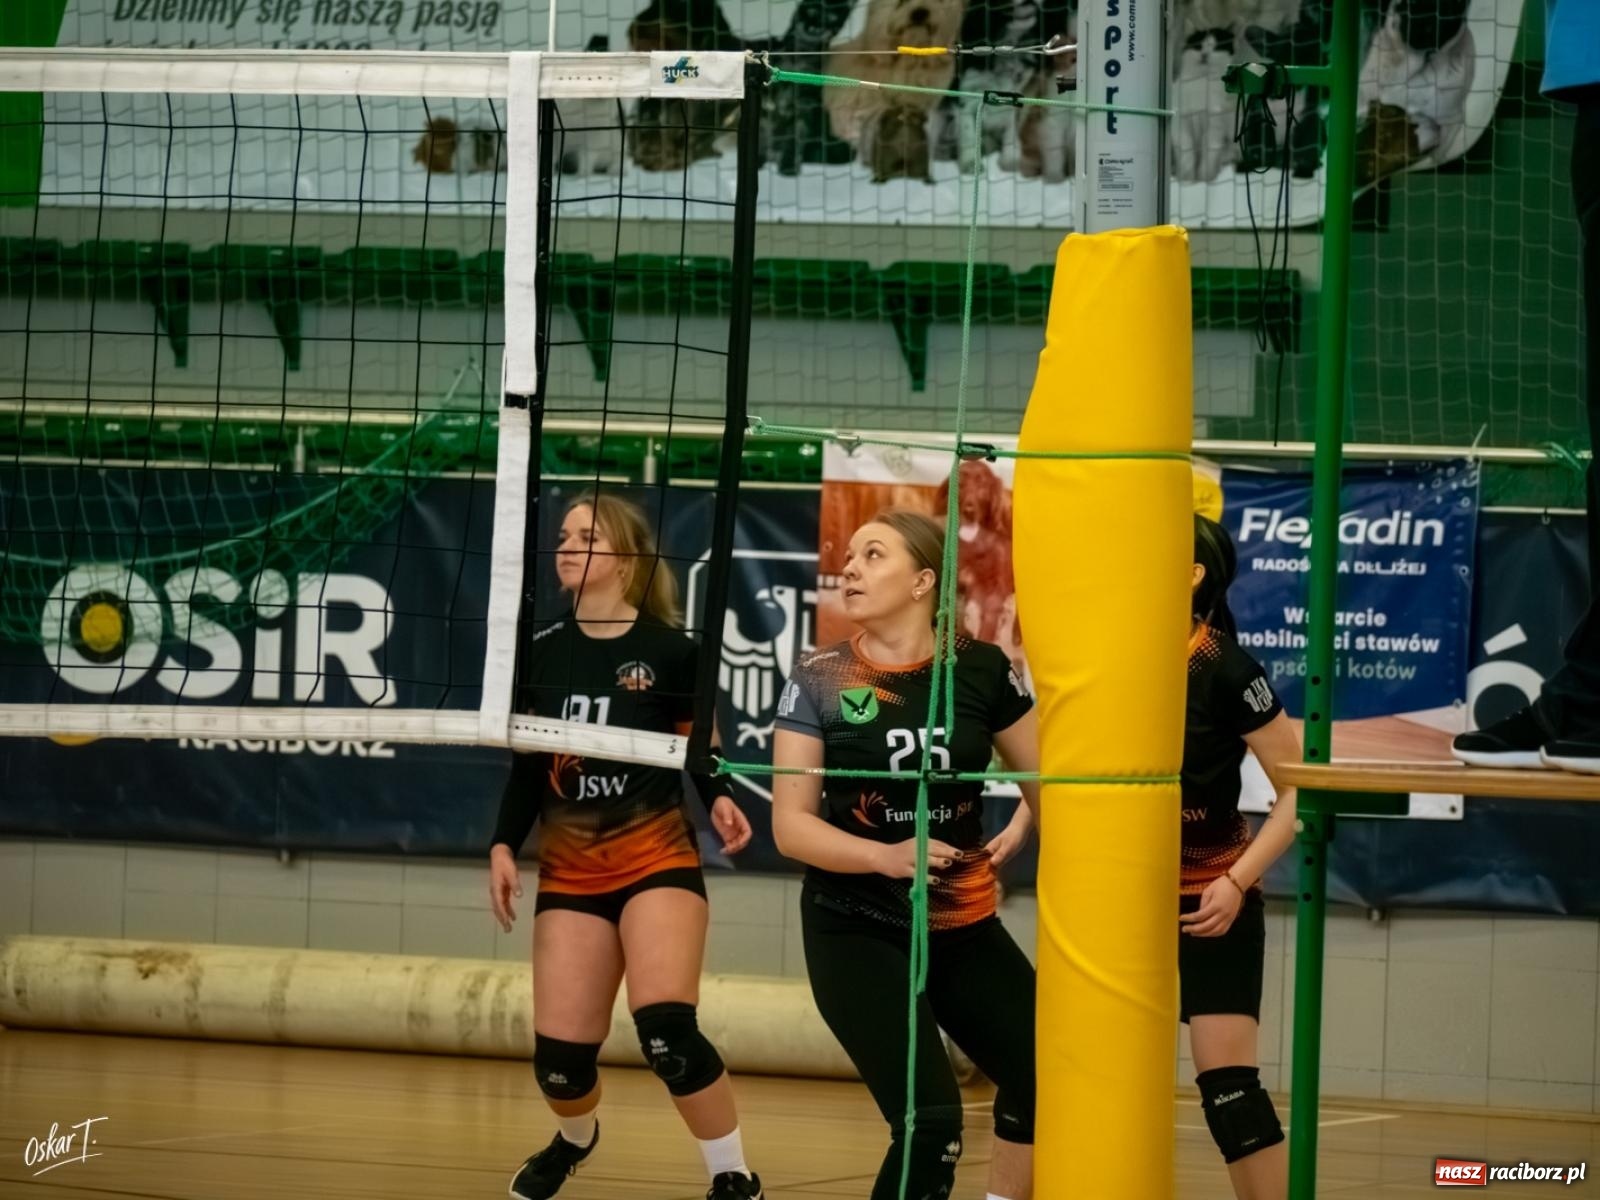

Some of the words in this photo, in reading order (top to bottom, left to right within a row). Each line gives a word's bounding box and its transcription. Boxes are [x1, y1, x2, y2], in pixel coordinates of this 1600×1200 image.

[113, 0, 247, 30] Dzielimy
[256, 0, 301, 34] się
[313, 0, 403, 35] naszą
[411, 0, 500, 36] pasją
[1238, 507, 1445, 549] Fleadin
[1252, 556, 1312, 572] RADOŚ
[1284, 607, 1388, 627] Warcie
[41, 562, 398, 707] OSiR
[1236, 628, 1350, 650] mobilnci
[1355, 633, 1441, 653] stawów
[1271, 655, 1308, 681] psó
[1348, 656, 1417, 681] kotów
[886, 727, 950, 778] 25
[577, 773, 629, 801] JSW
[885, 804, 952, 824] Funcja
[1182, 808, 1208, 822] SW
